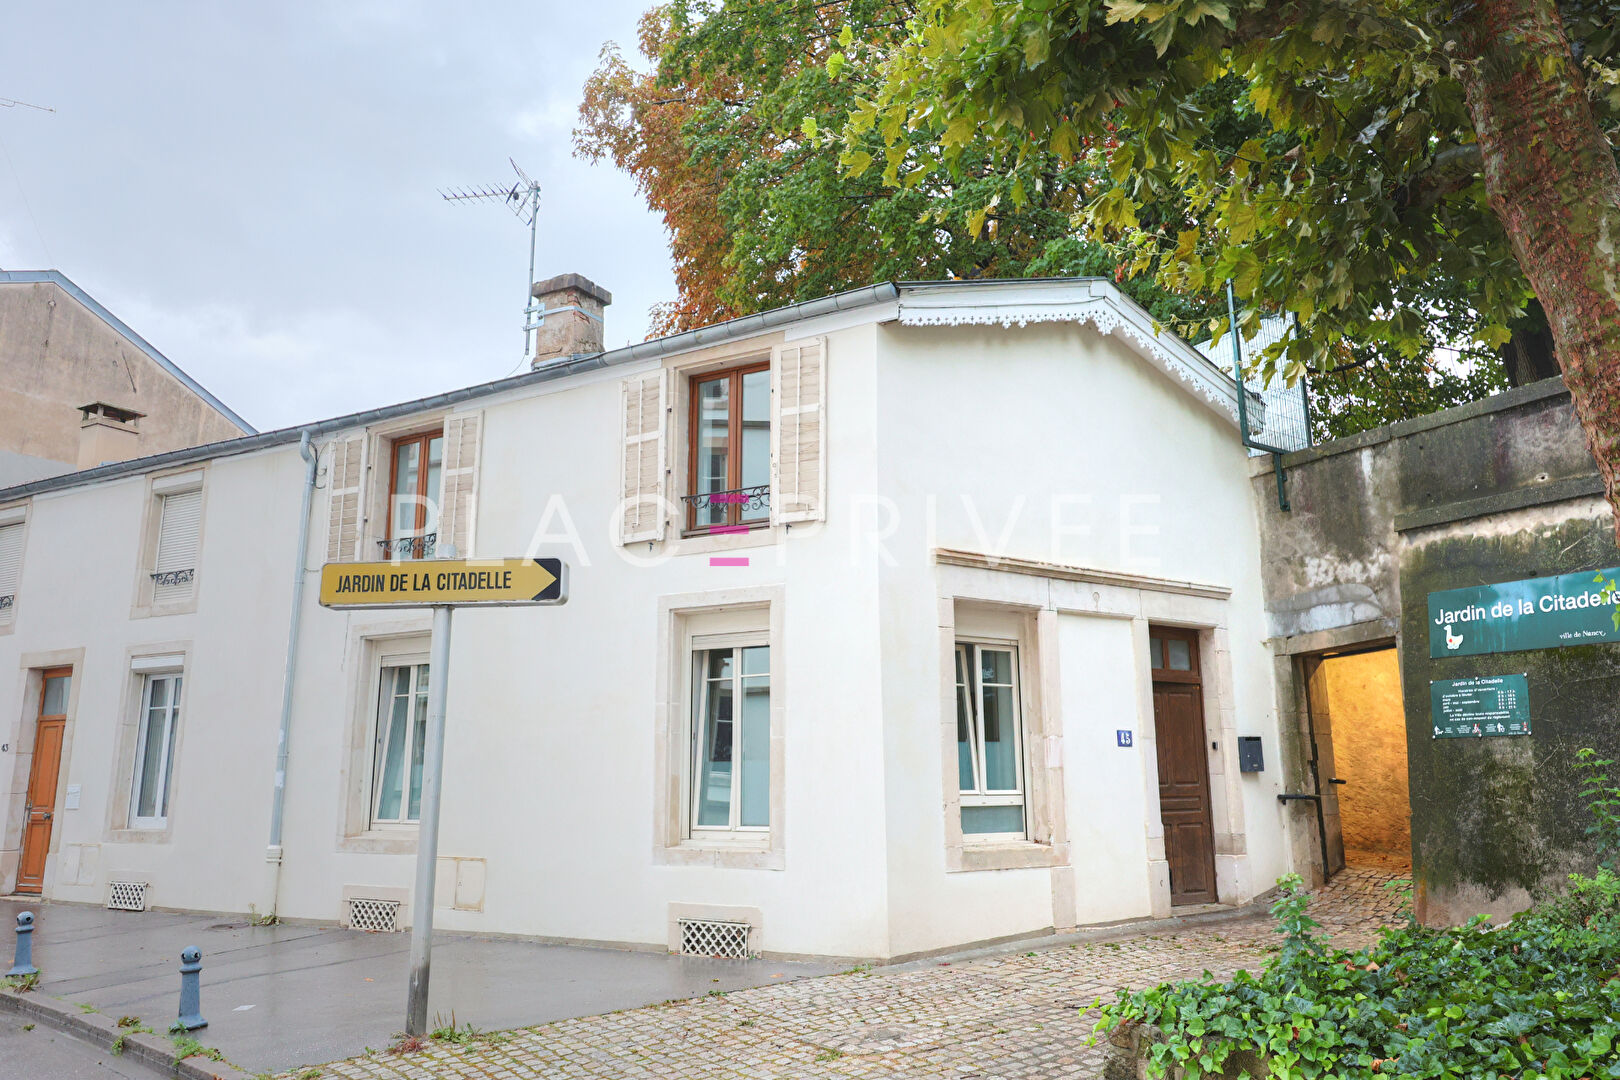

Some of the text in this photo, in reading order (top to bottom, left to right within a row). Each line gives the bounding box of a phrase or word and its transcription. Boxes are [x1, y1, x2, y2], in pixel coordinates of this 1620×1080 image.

[336, 570, 512, 593] JARDIN DE LA CITADELLE
[1435, 588, 1620, 625] Jardin de la Citadele
[1120, 732, 1131, 744] 45
